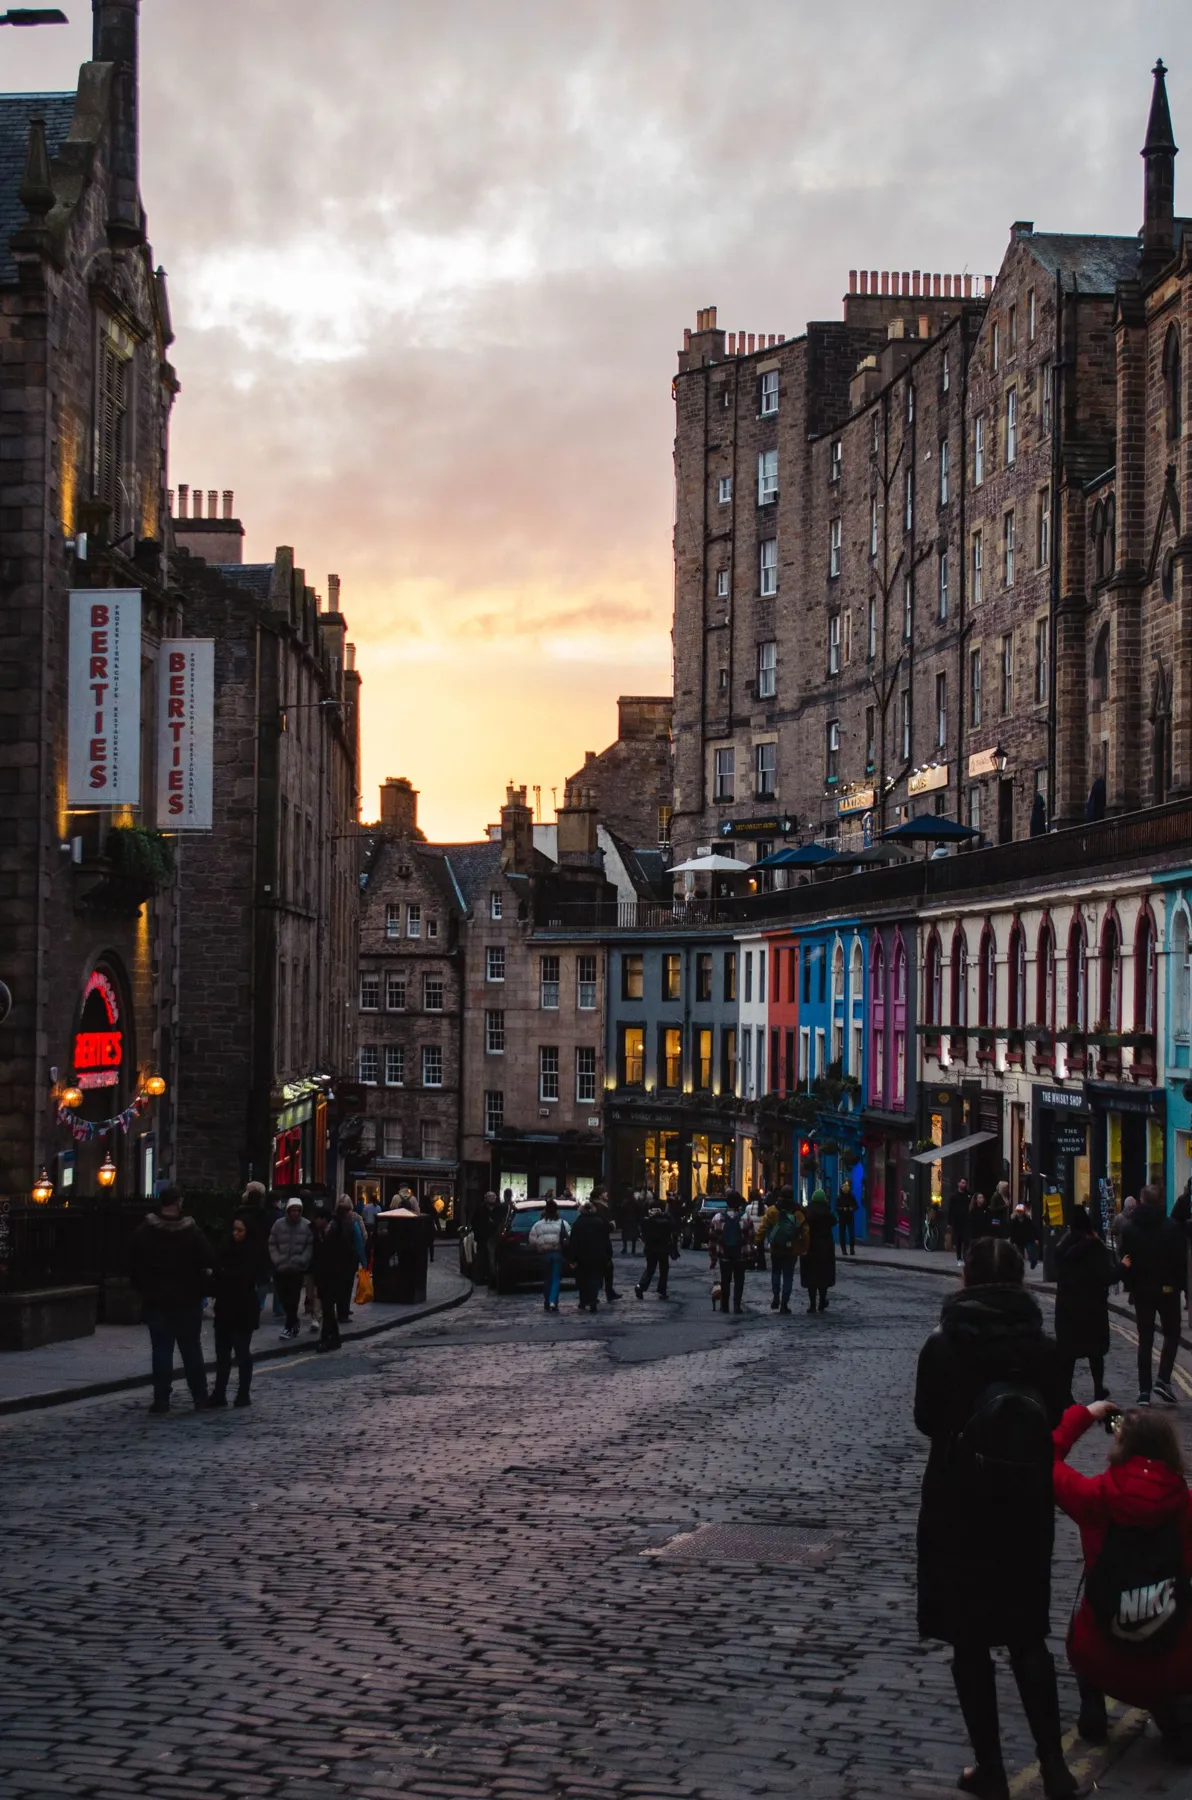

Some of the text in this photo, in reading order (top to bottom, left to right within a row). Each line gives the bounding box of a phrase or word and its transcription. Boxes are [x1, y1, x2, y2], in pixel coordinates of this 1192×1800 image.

[89, 604, 110, 789] BERTIES
[168, 652, 186, 815] BERTIES
[1042, 1091, 1082, 1107] THE WHISKY SHOP
[1119, 1576, 1176, 1624] NIKE
